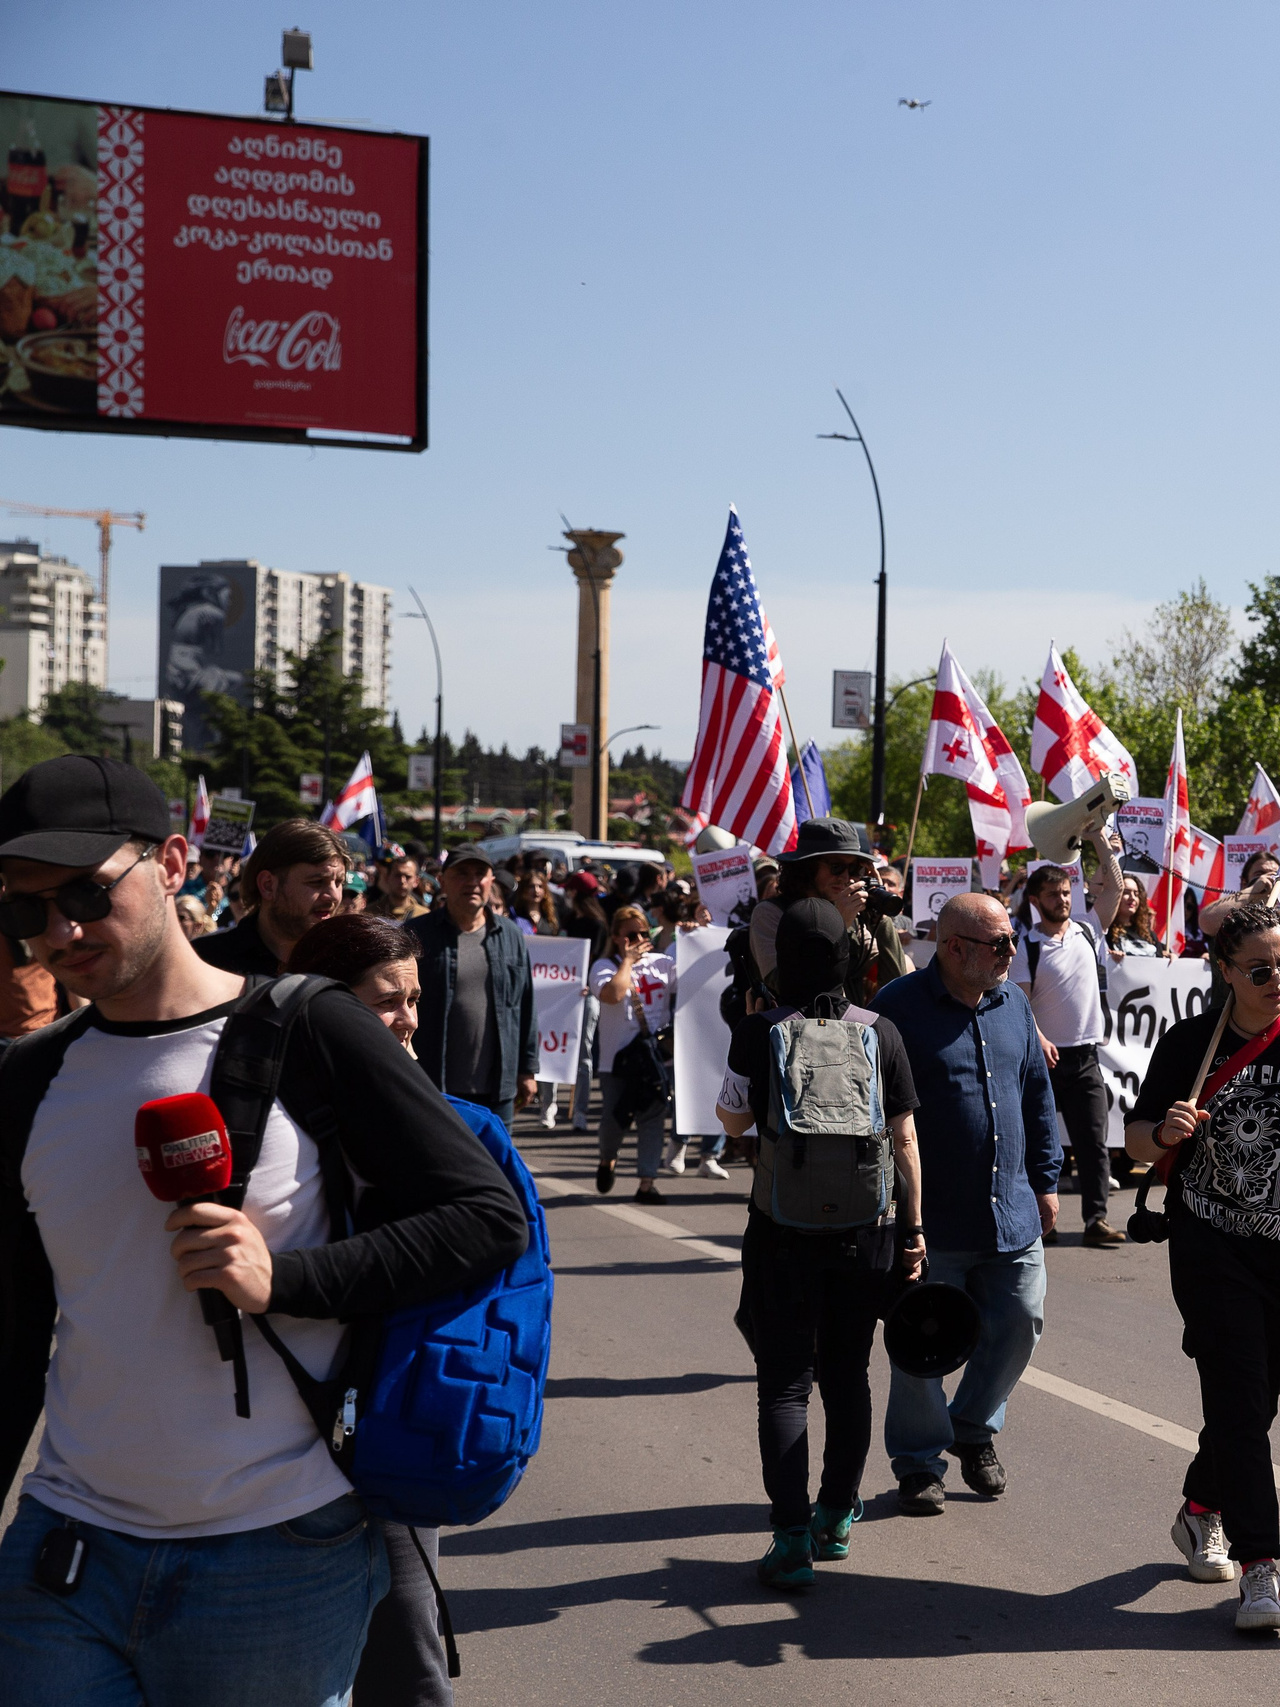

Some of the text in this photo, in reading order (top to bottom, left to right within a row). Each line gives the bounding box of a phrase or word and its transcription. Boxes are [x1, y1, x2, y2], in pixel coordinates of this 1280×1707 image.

[228, 134, 343, 169] აღნიშნე
[214, 166, 356, 196] აღდგომის
[187, 194, 382, 232] დღესასწაული
[173, 224, 394, 261] კოკა-კოლასთან
[236, 257, 334, 290] ერთად
[163, 1133, 218, 1153] PALITRA
[172, 1145, 215, 1168] NEWS
